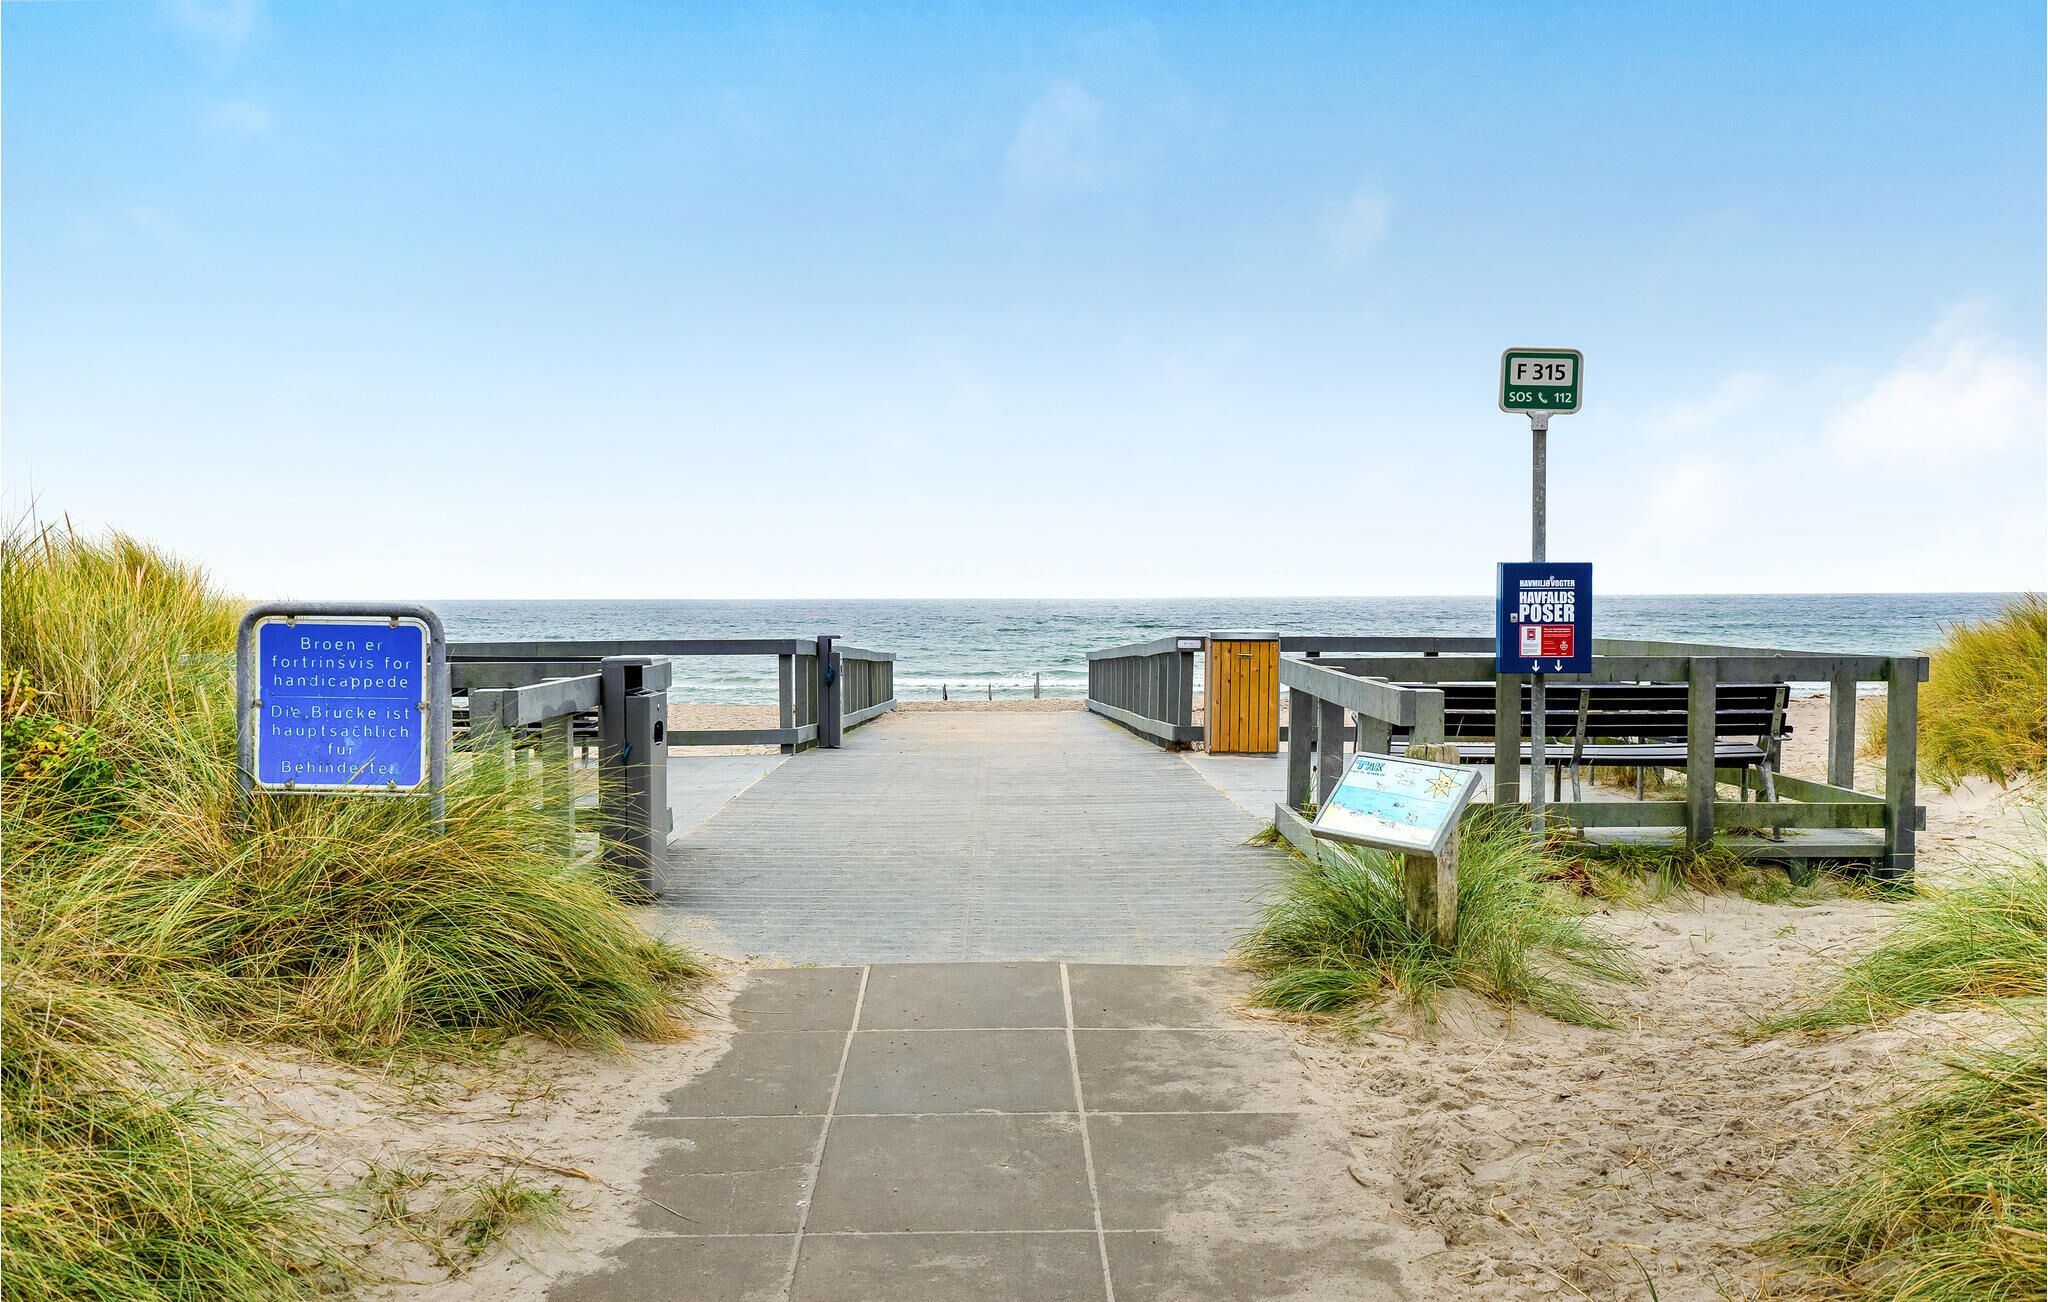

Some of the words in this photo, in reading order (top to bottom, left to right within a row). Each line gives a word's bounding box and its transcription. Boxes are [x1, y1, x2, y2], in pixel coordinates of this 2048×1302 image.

[1517, 363, 1527, 380] F
[1532, 363, 1566, 380] 315
[1509, 391, 1532, 402] SOS
[1554, 392, 1572, 403] 112
[1519, 591, 1575, 604] HAVFALDS
[1519, 604, 1575, 623] POSER
[300, 636, 356, 650] Broen
[365, 641, 383, 651] er
[271, 655, 374, 669] fortrinsvis
[384, 656, 411, 670] for
[273, 674, 409, 690] handicappede
[386, 706, 410, 720] ist
